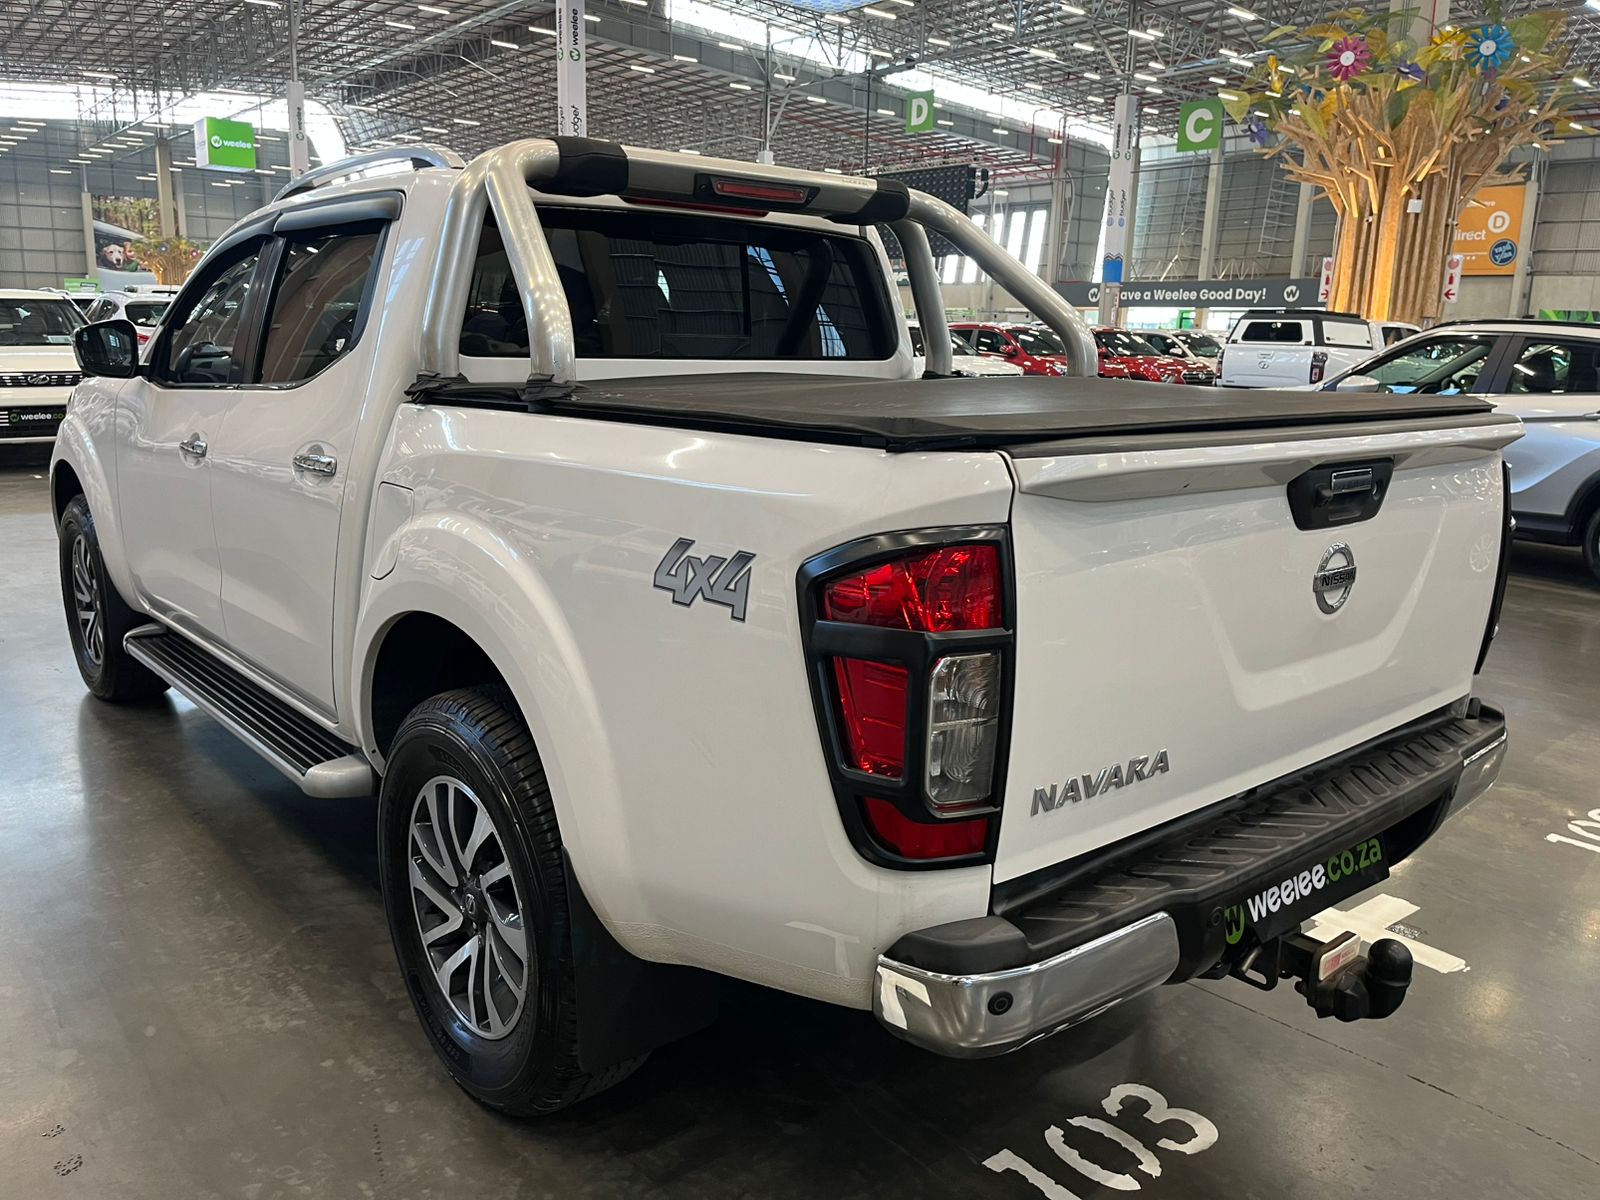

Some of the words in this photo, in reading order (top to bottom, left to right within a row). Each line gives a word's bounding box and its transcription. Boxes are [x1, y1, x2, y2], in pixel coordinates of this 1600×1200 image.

[571, 8, 579, 46] weelee
[571, 105, 582, 137] udget
[911, 98, 928, 126] D
[1186, 108, 1214, 142] C
[1120, 291, 1141, 300] ave
[1143, 291, 1151, 300] a
[1154, 289, 1197, 300] Weelee
[1200, 288, 1232, 300] Good
[1235, 288, 1266, 304] Day!
[653, 537, 757, 623] 4x4
[1030, 748, 1170, 817] NAVARA
[981, 1083, 1219, 1200] 103
